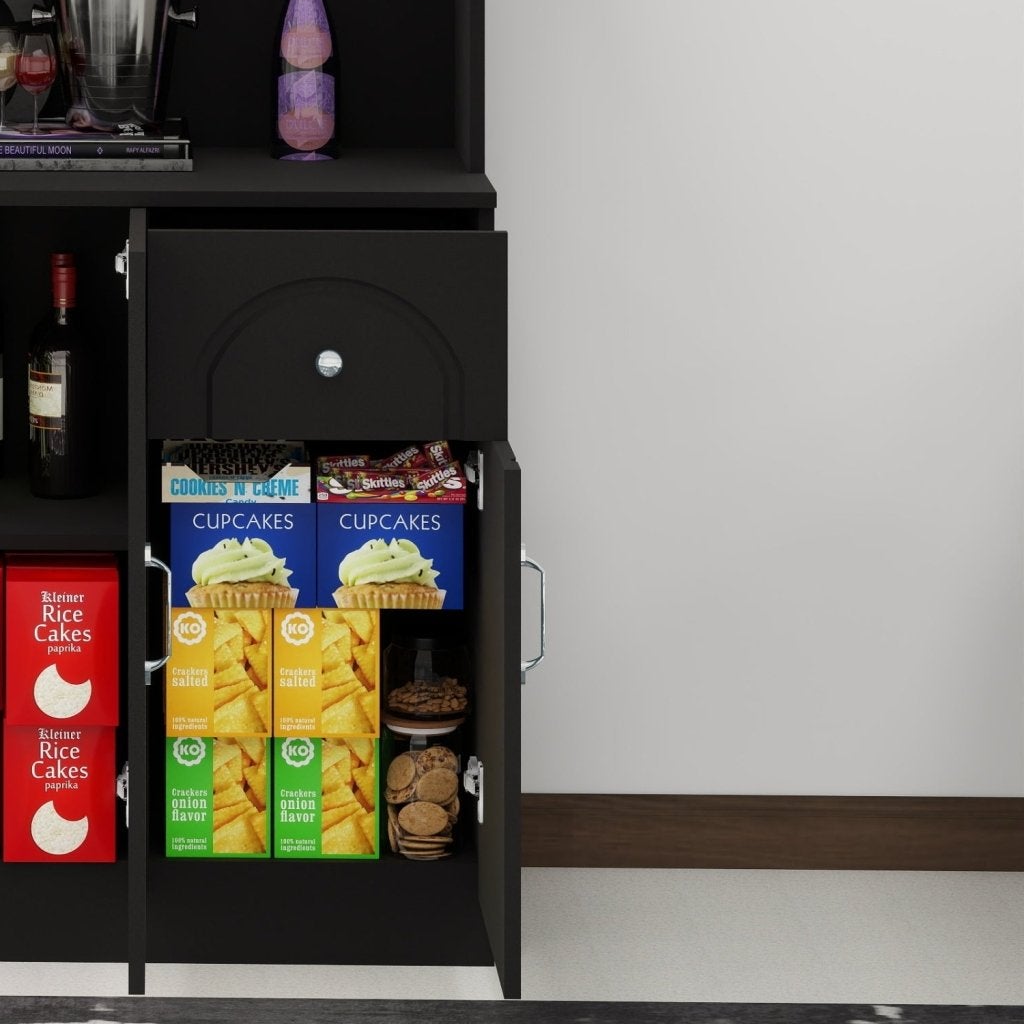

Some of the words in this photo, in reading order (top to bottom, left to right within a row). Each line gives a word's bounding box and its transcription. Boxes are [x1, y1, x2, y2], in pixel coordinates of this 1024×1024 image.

[5, 146, 46, 154] BEAUTIFUL
[48, 146, 72, 154] MOON
[322, 458, 366, 474] Skittles
[362, 478, 406, 490] Skittles
[416, 466, 457, 491] Skittles
[170, 478, 227, 496] COOKIES
[192, 513, 294, 530] CUPCAKES
[340, 514, 441, 530] CUPCAKES
[43, 606, 84, 622] Rice
[34, 624, 92, 642] Cakes
[180, 623, 200, 634] KO
[288, 623, 308, 634] KO
[48, 644, 82, 655] paprika
[172, 667, 208, 676] Crackers
[280, 667, 316, 676] Crackers
[172, 676, 208, 687] salted
[280, 676, 316, 687] salted
[38, 728, 82, 740] Kleiner
[40, 742, 80, 760] Rice
[180, 744, 200, 755] KO
[288, 746, 308, 756] KO
[31, 761, 89, 780] Cakes
[172, 788, 208, 796] Crackers
[280, 789, 316, 797] Crackers
[172, 797, 206, 809] onion
[280, 798, 316, 810] onion
[172, 810, 206, 822] flavor
[280, 810, 316, 823] flavor
[280, 844, 316, 852] ingredients
